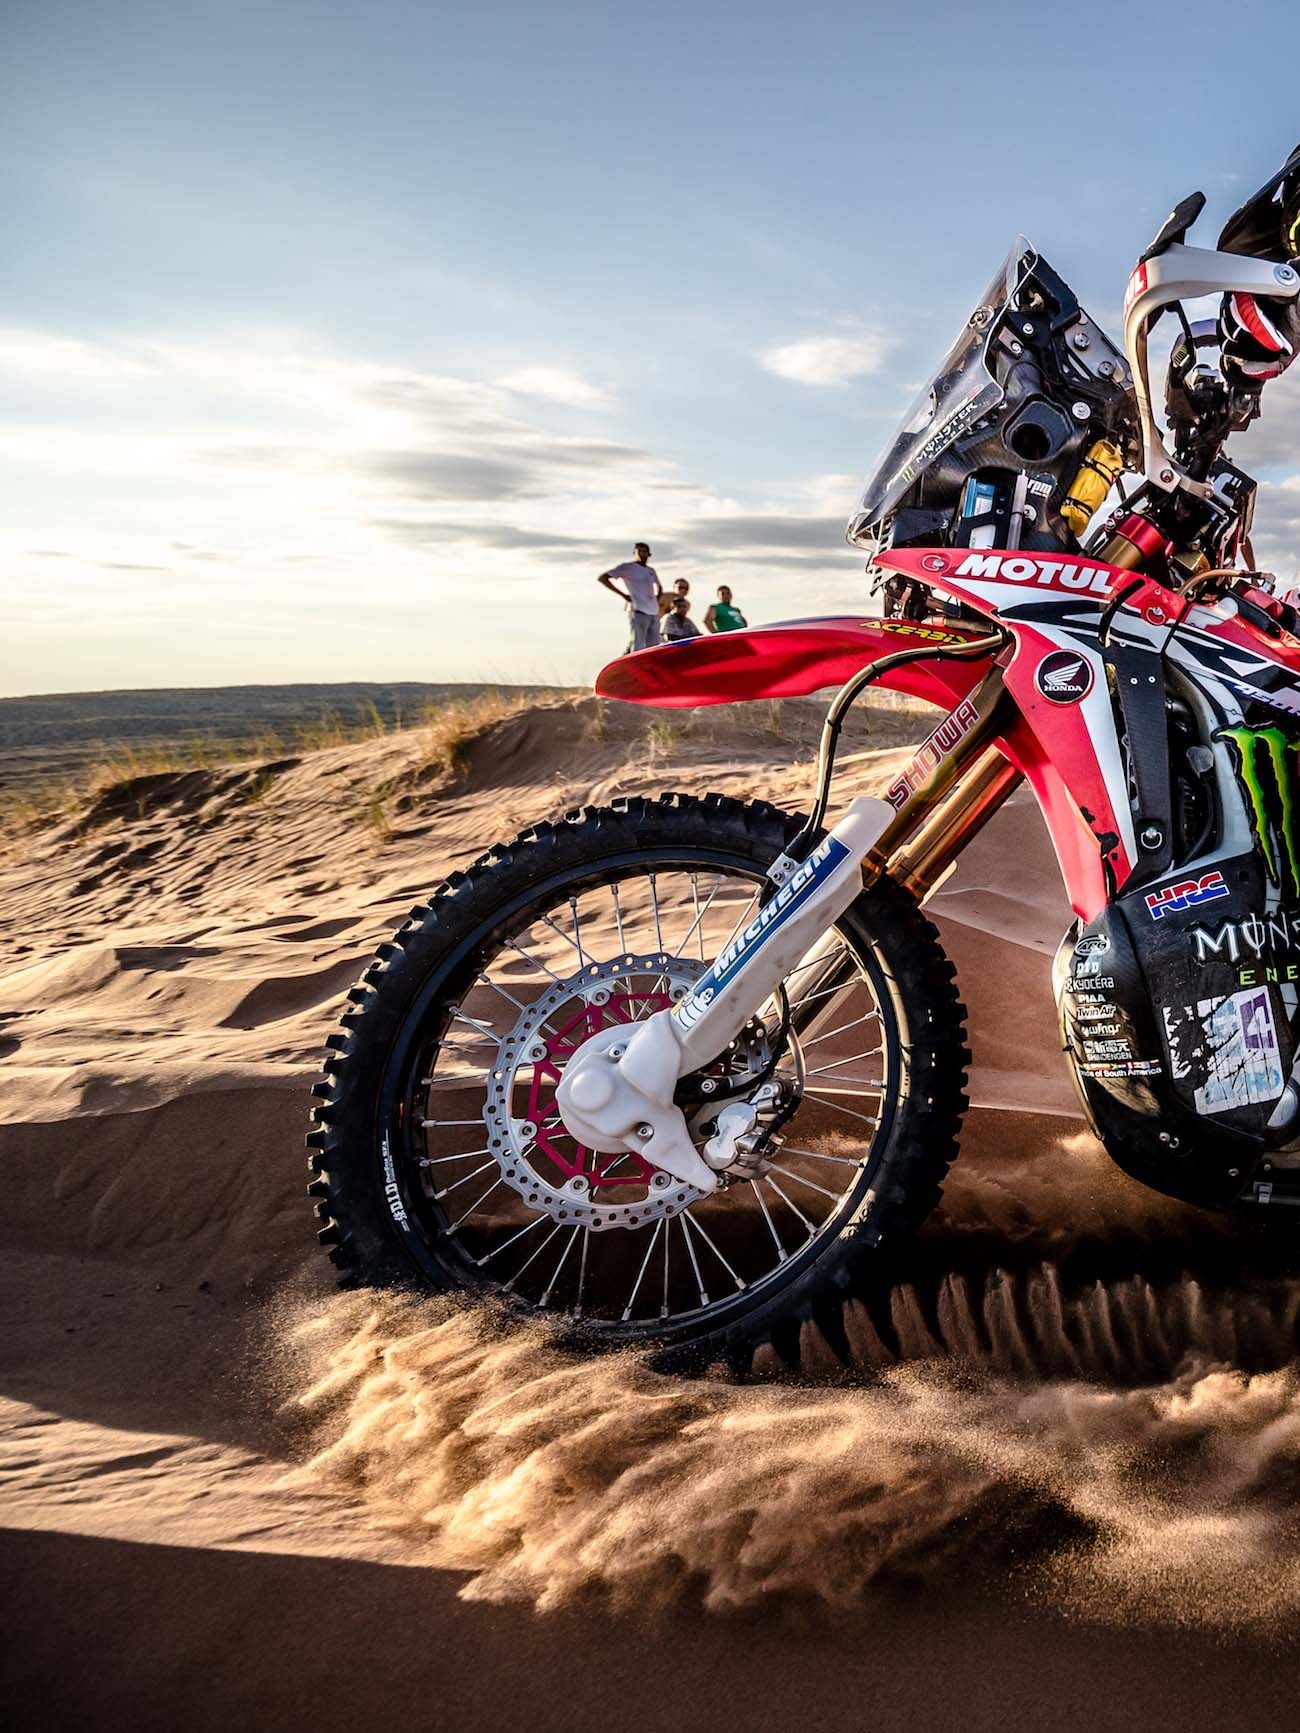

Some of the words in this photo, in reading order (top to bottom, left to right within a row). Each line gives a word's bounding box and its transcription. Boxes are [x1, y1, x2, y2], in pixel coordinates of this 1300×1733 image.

[954, 554, 1114, 594] MOTUL
[1043, 684, 1083, 692] HONDA
[886, 698, 981, 810] SHOWA
[1145, 870, 1230, 921] HRC
[712, 842, 833, 980] MICHELIN
[1077, 1007, 1099, 1017] Twin
[1100, 1003, 1116, 1015] Air
[1078, 994, 1106, 1003] PIAA
[1103, 1069, 1127, 1077] South
[1128, 1067, 1162, 1076] America
